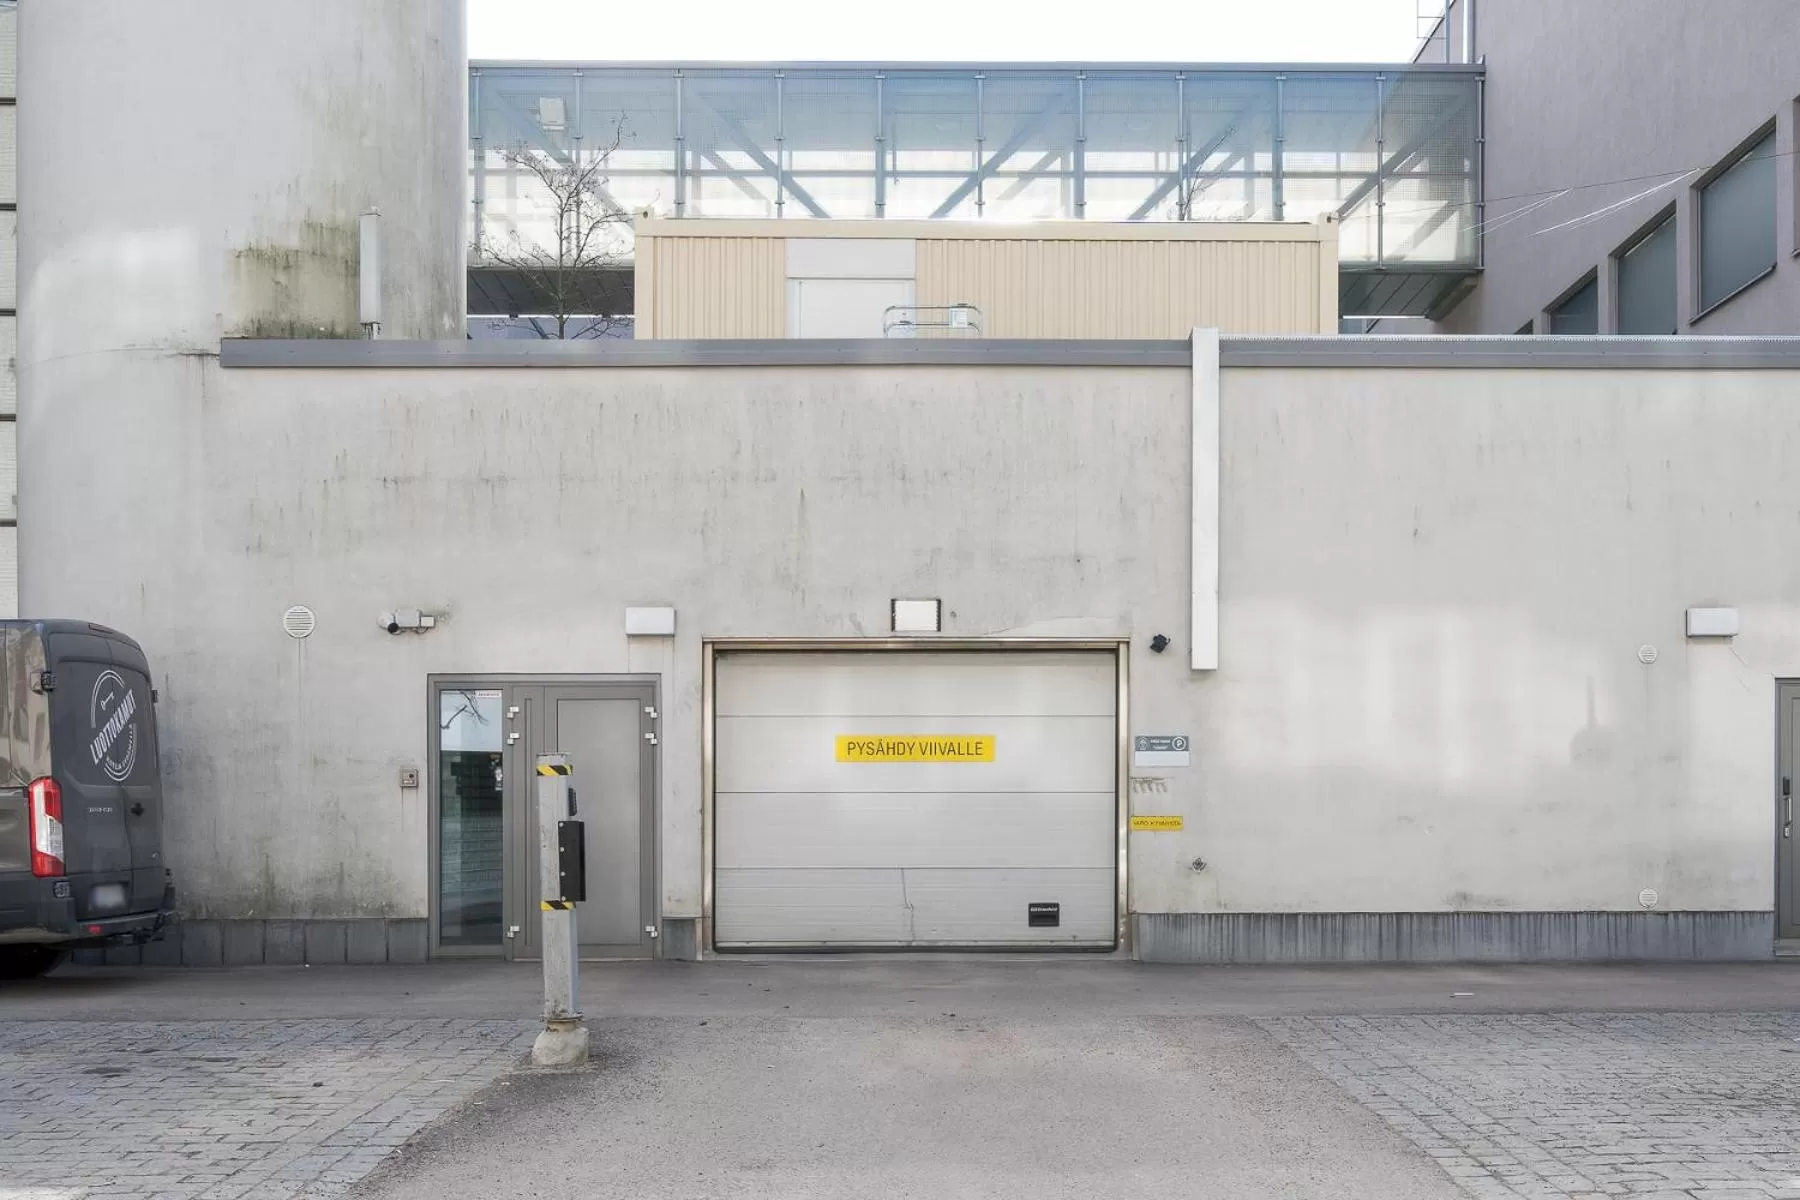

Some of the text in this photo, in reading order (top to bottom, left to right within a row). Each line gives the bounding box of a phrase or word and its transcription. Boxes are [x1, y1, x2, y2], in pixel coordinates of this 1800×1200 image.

[90, 688, 137, 767] LUOTTOKAMUT
[847, 738, 984, 756] PYSÄHDY VIIVALLE
